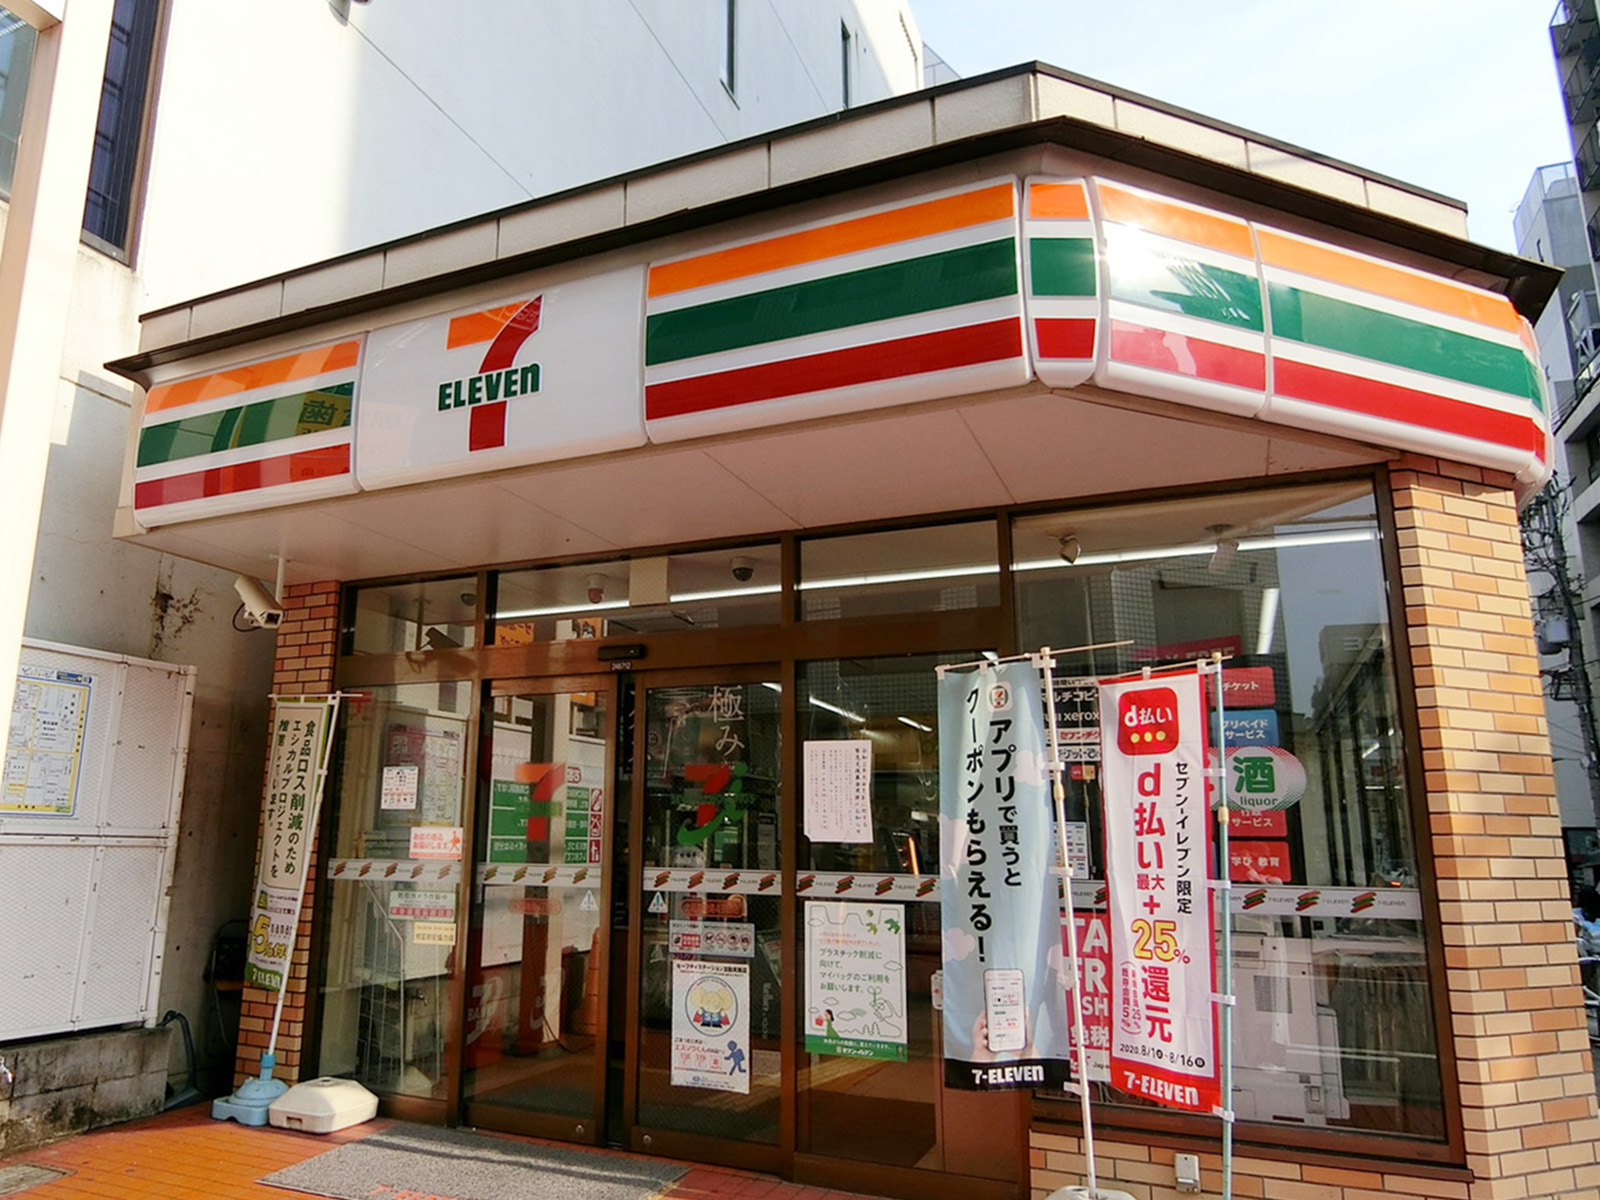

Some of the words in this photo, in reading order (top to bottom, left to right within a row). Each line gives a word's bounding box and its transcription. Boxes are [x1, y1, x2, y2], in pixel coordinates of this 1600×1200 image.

[447, 295, 543, 452] 7
[707, 685, 745, 756] 極み
[1064, 710, 1099, 721] xerox
[1124, 705, 1173, 727] d払い
[1225, 729, 1266, 740] サービス
[1232, 756, 1277, 794] 酒
[269, 720, 302, 878] エシカルプロジェクトを
[284, 720, 316, 875] 食品ロス削減のため
[989, 718, 1022, 887] アプリで買うと
[1240, 795, 1279, 807] liquor
[1135, 763, 1166, 869] d払い
[1231, 817, 1274, 828] サービス
[1136, 874, 1165, 890] 最大
[1131, 918, 1191, 965] 25%
[819, 948, 882, 960] プラスチック削減に
[819, 959, 844, 970] 向けて、
[819, 971, 890, 984] マイバッグのご利用を
[820, 982, 864, 994] お願いします。
[1141, 965, 1173, 1043] 還元
